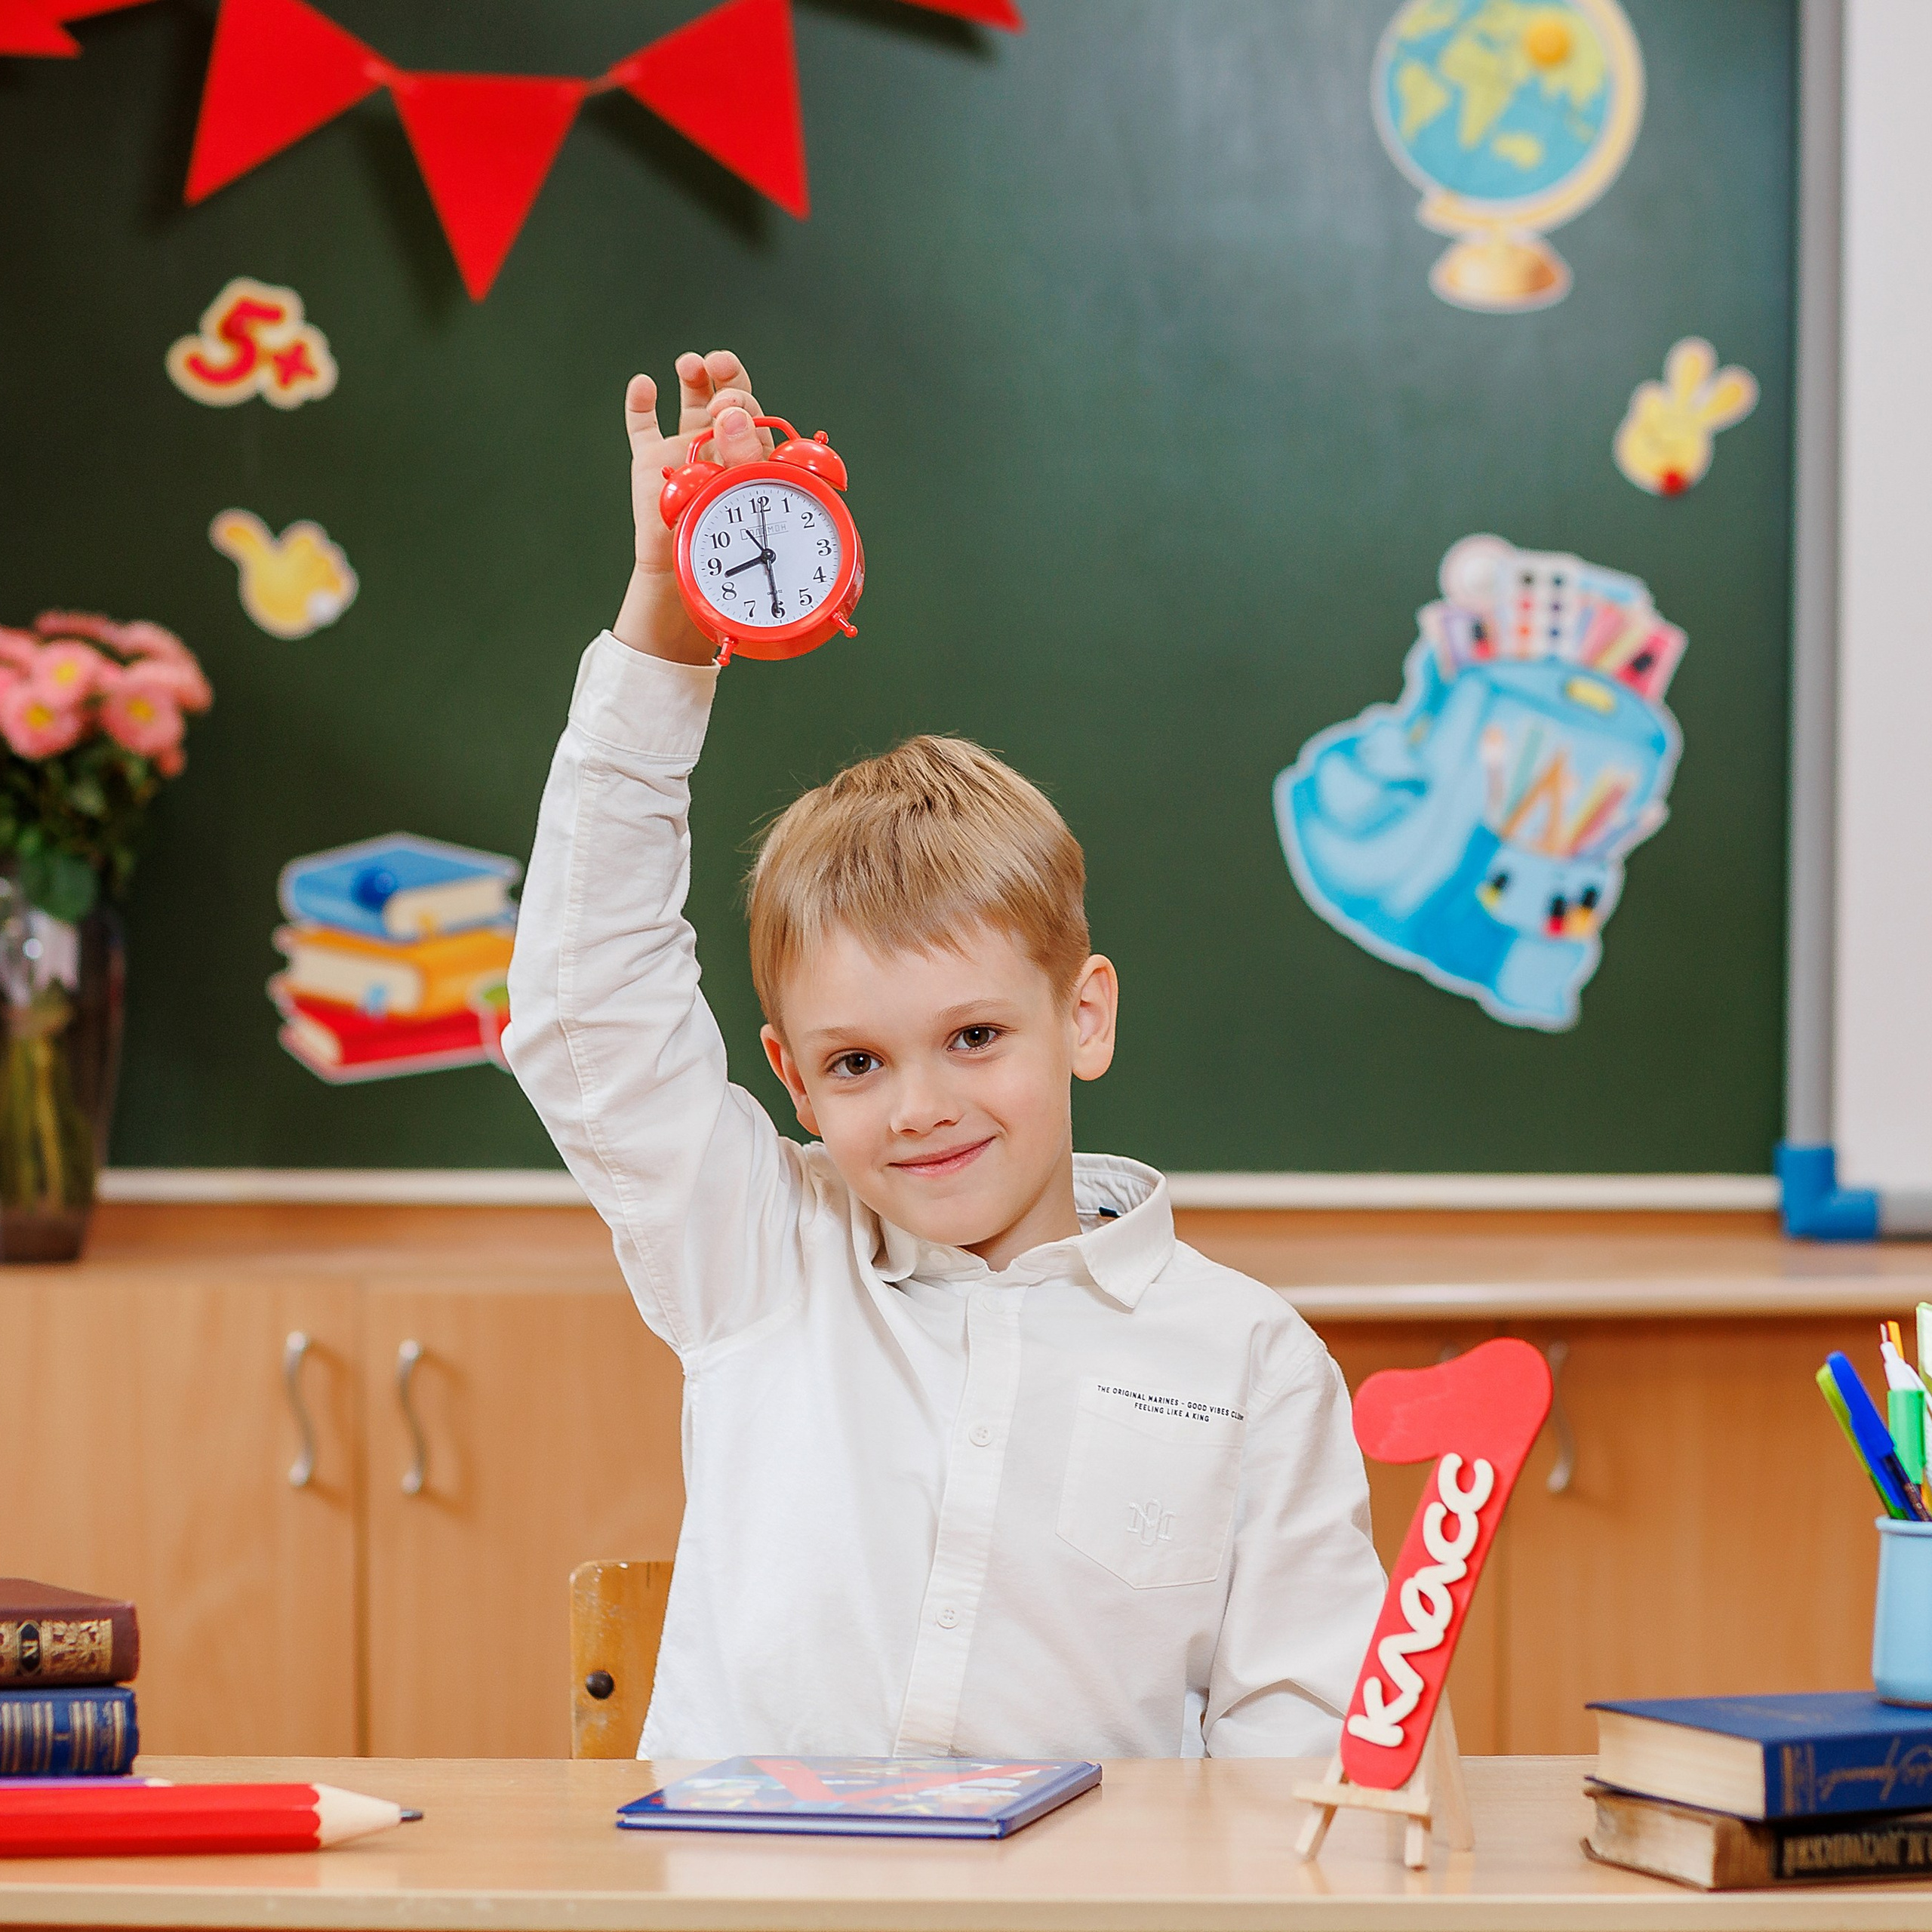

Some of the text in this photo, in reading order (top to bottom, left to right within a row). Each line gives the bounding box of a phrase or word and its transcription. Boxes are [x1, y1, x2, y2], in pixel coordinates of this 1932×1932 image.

[748, 496, 771, 515] 12
[781, 497, 792, 514] 1
[725, 506, 744, 525] 11
[801, 512, 816, 529] 2
[709, 531, 731, 549] 10
[817, 539, 832, 556] 3
[707, 558, 722, 576] 9
[813, 566, 827, 583] 4
[721, 582, 737, 600] 8
[798, 588, 813, 606] 5
[743, 600, 756, 618] 7
[771, 601, 786, 619] 6
[1097, 1385, 1110, 1394] THE
[1112, 1387, 1146, 1401] ORIGINAL
[1148, 1395, 1179, 1406] MARINES
[1187, 1401, 1208, 1412] GOOD
[1210, 1406, 1229, 1417] VIBES
[1134, 1402, 1164, 1414] FEELING
[1167, 1408, 1183, 1417] LIKE
[1192, 1413, 1210, 1423] KING
